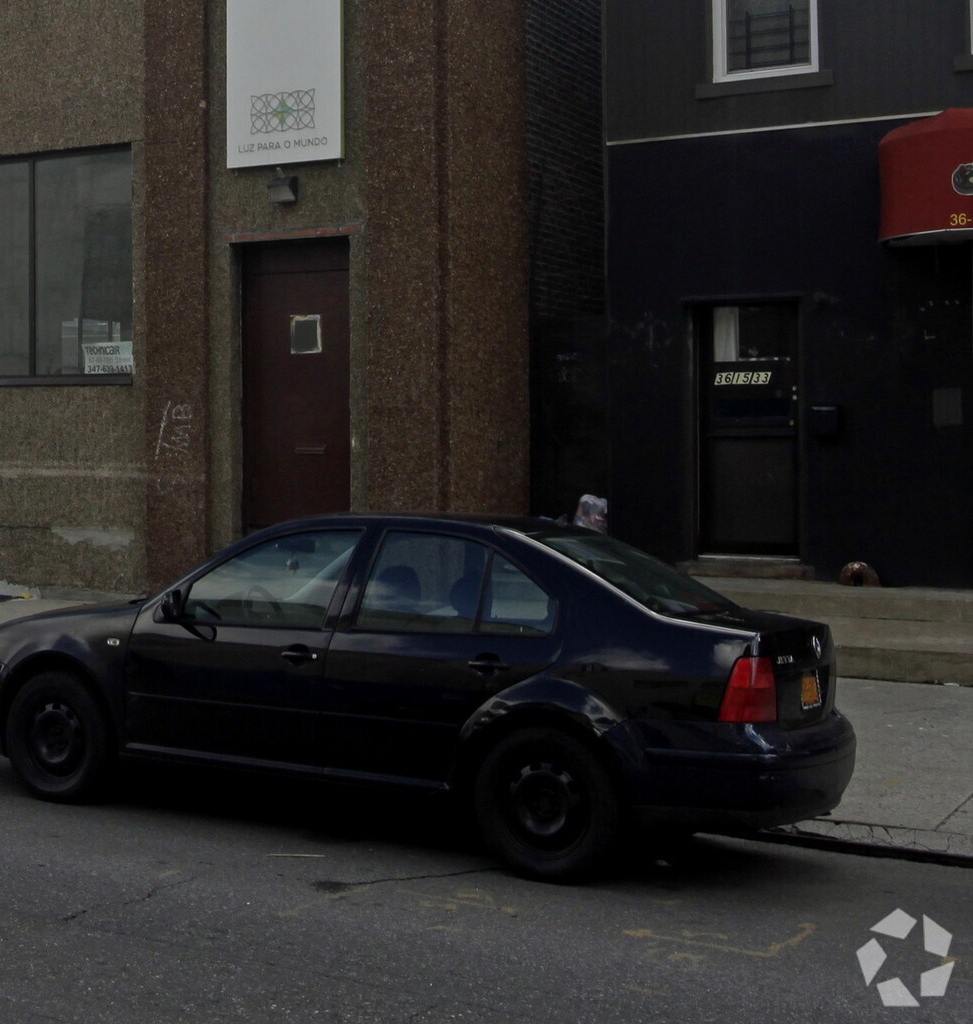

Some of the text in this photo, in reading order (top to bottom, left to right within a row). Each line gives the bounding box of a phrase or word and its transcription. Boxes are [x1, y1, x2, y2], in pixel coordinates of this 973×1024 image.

[238, 136, 328, 154] LUZ PARA O MUNDO
